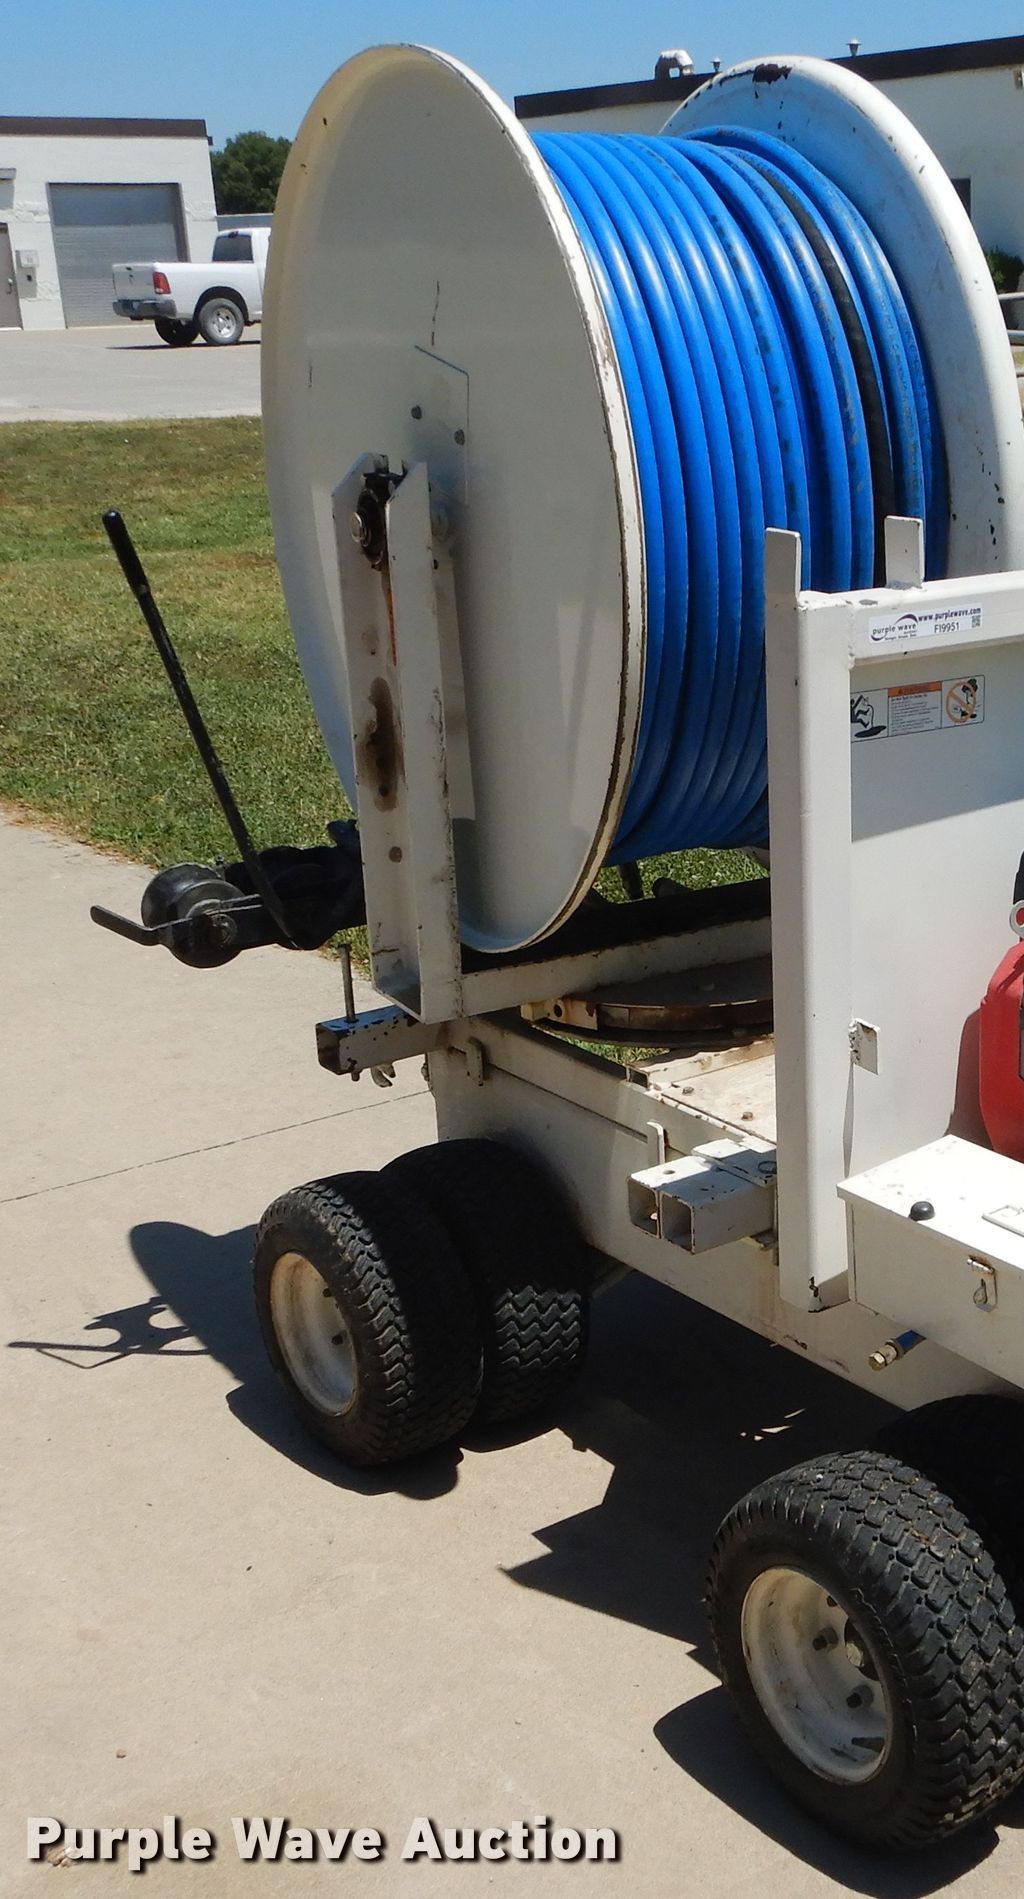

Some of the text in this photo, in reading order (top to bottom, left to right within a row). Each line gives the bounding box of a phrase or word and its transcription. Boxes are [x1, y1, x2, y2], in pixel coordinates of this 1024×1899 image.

[918, 607, 982, 622] www.purplewave.com
[872, 624, 896, 636] purple
[898, 623, 917, 632] wave
